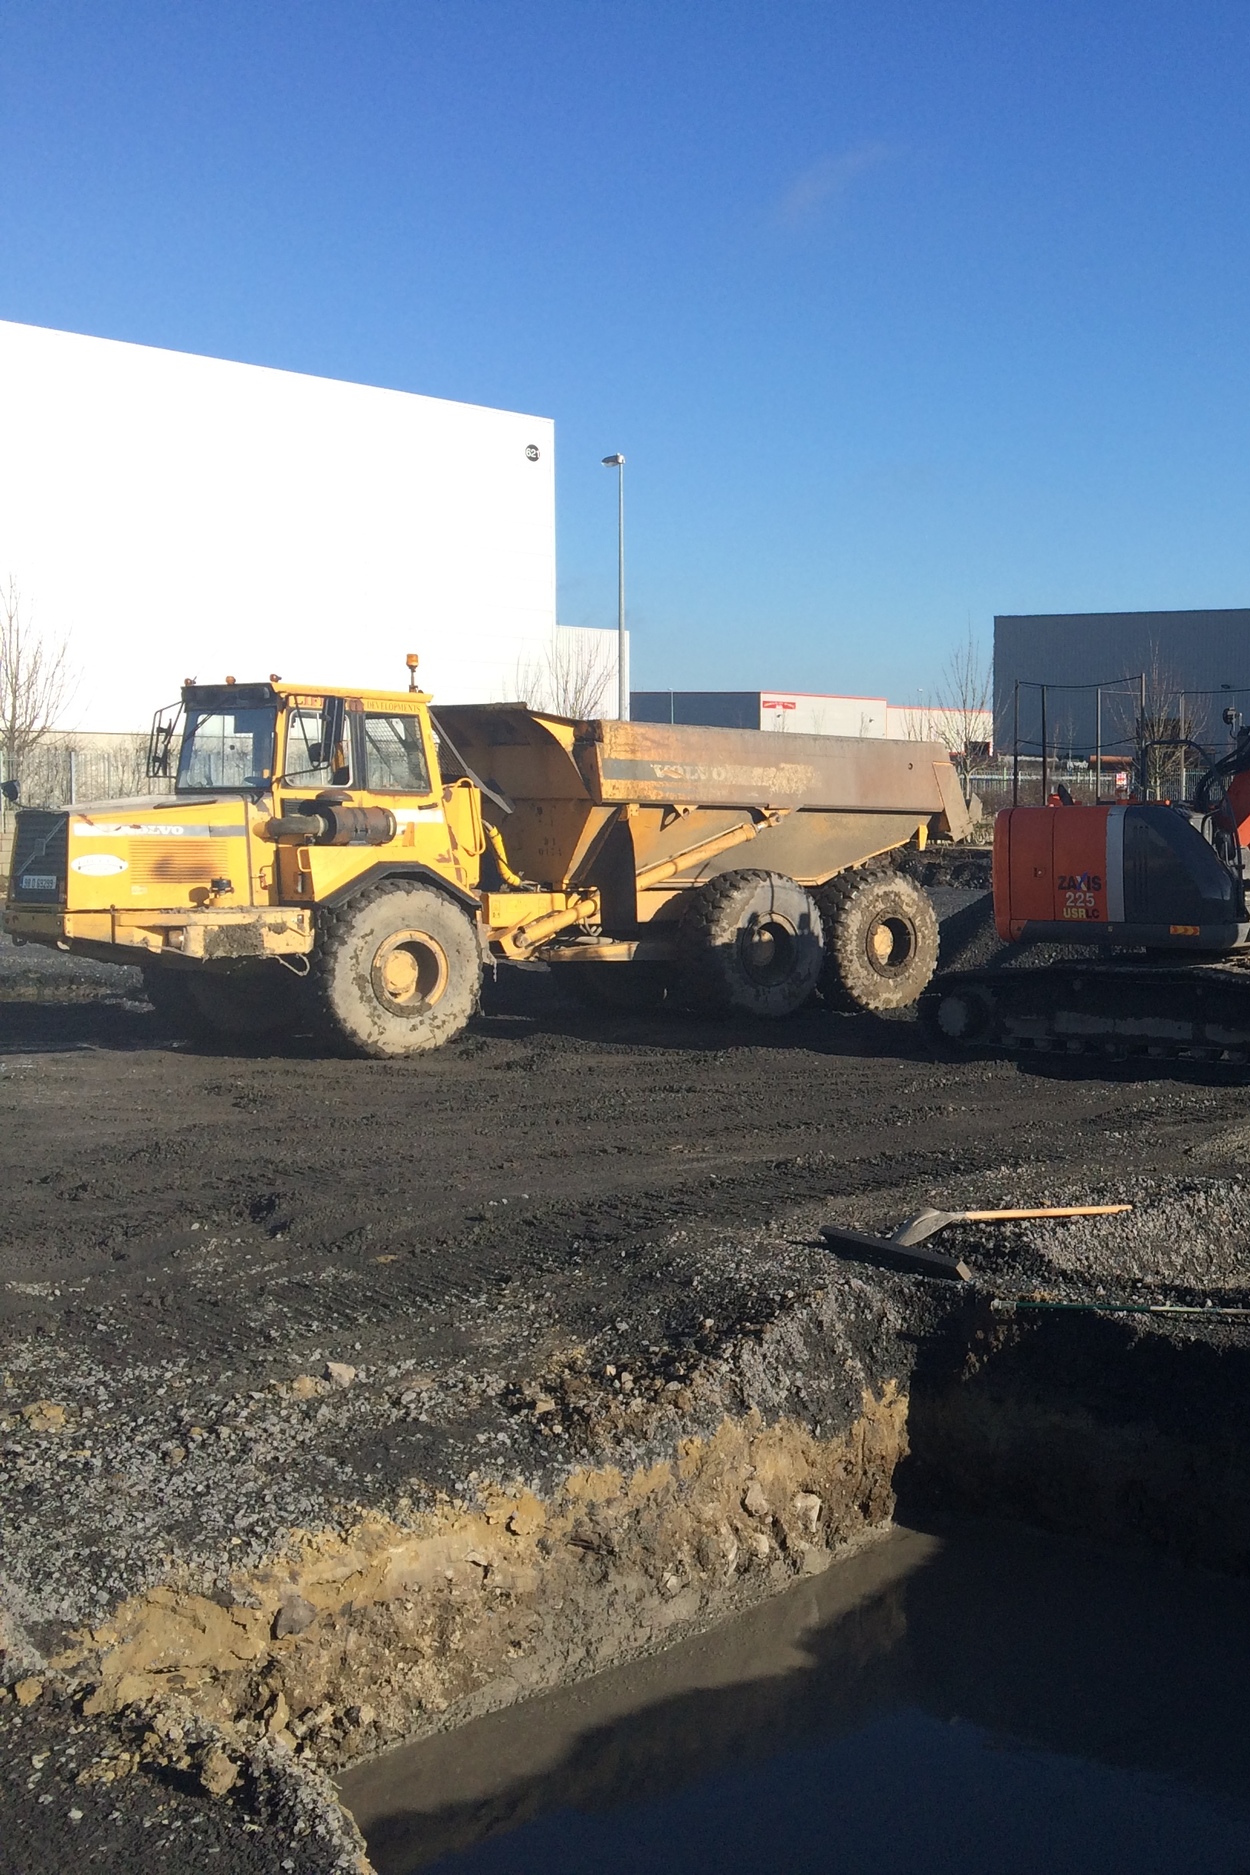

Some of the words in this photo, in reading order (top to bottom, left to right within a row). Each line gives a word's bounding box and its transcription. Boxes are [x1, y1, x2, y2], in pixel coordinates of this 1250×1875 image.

[366, 701, 421, 712] DEVELOPMENTS
[1058, 872, 1101, 891] ZAXIS
[1066, 891, 1095, 907] 225
